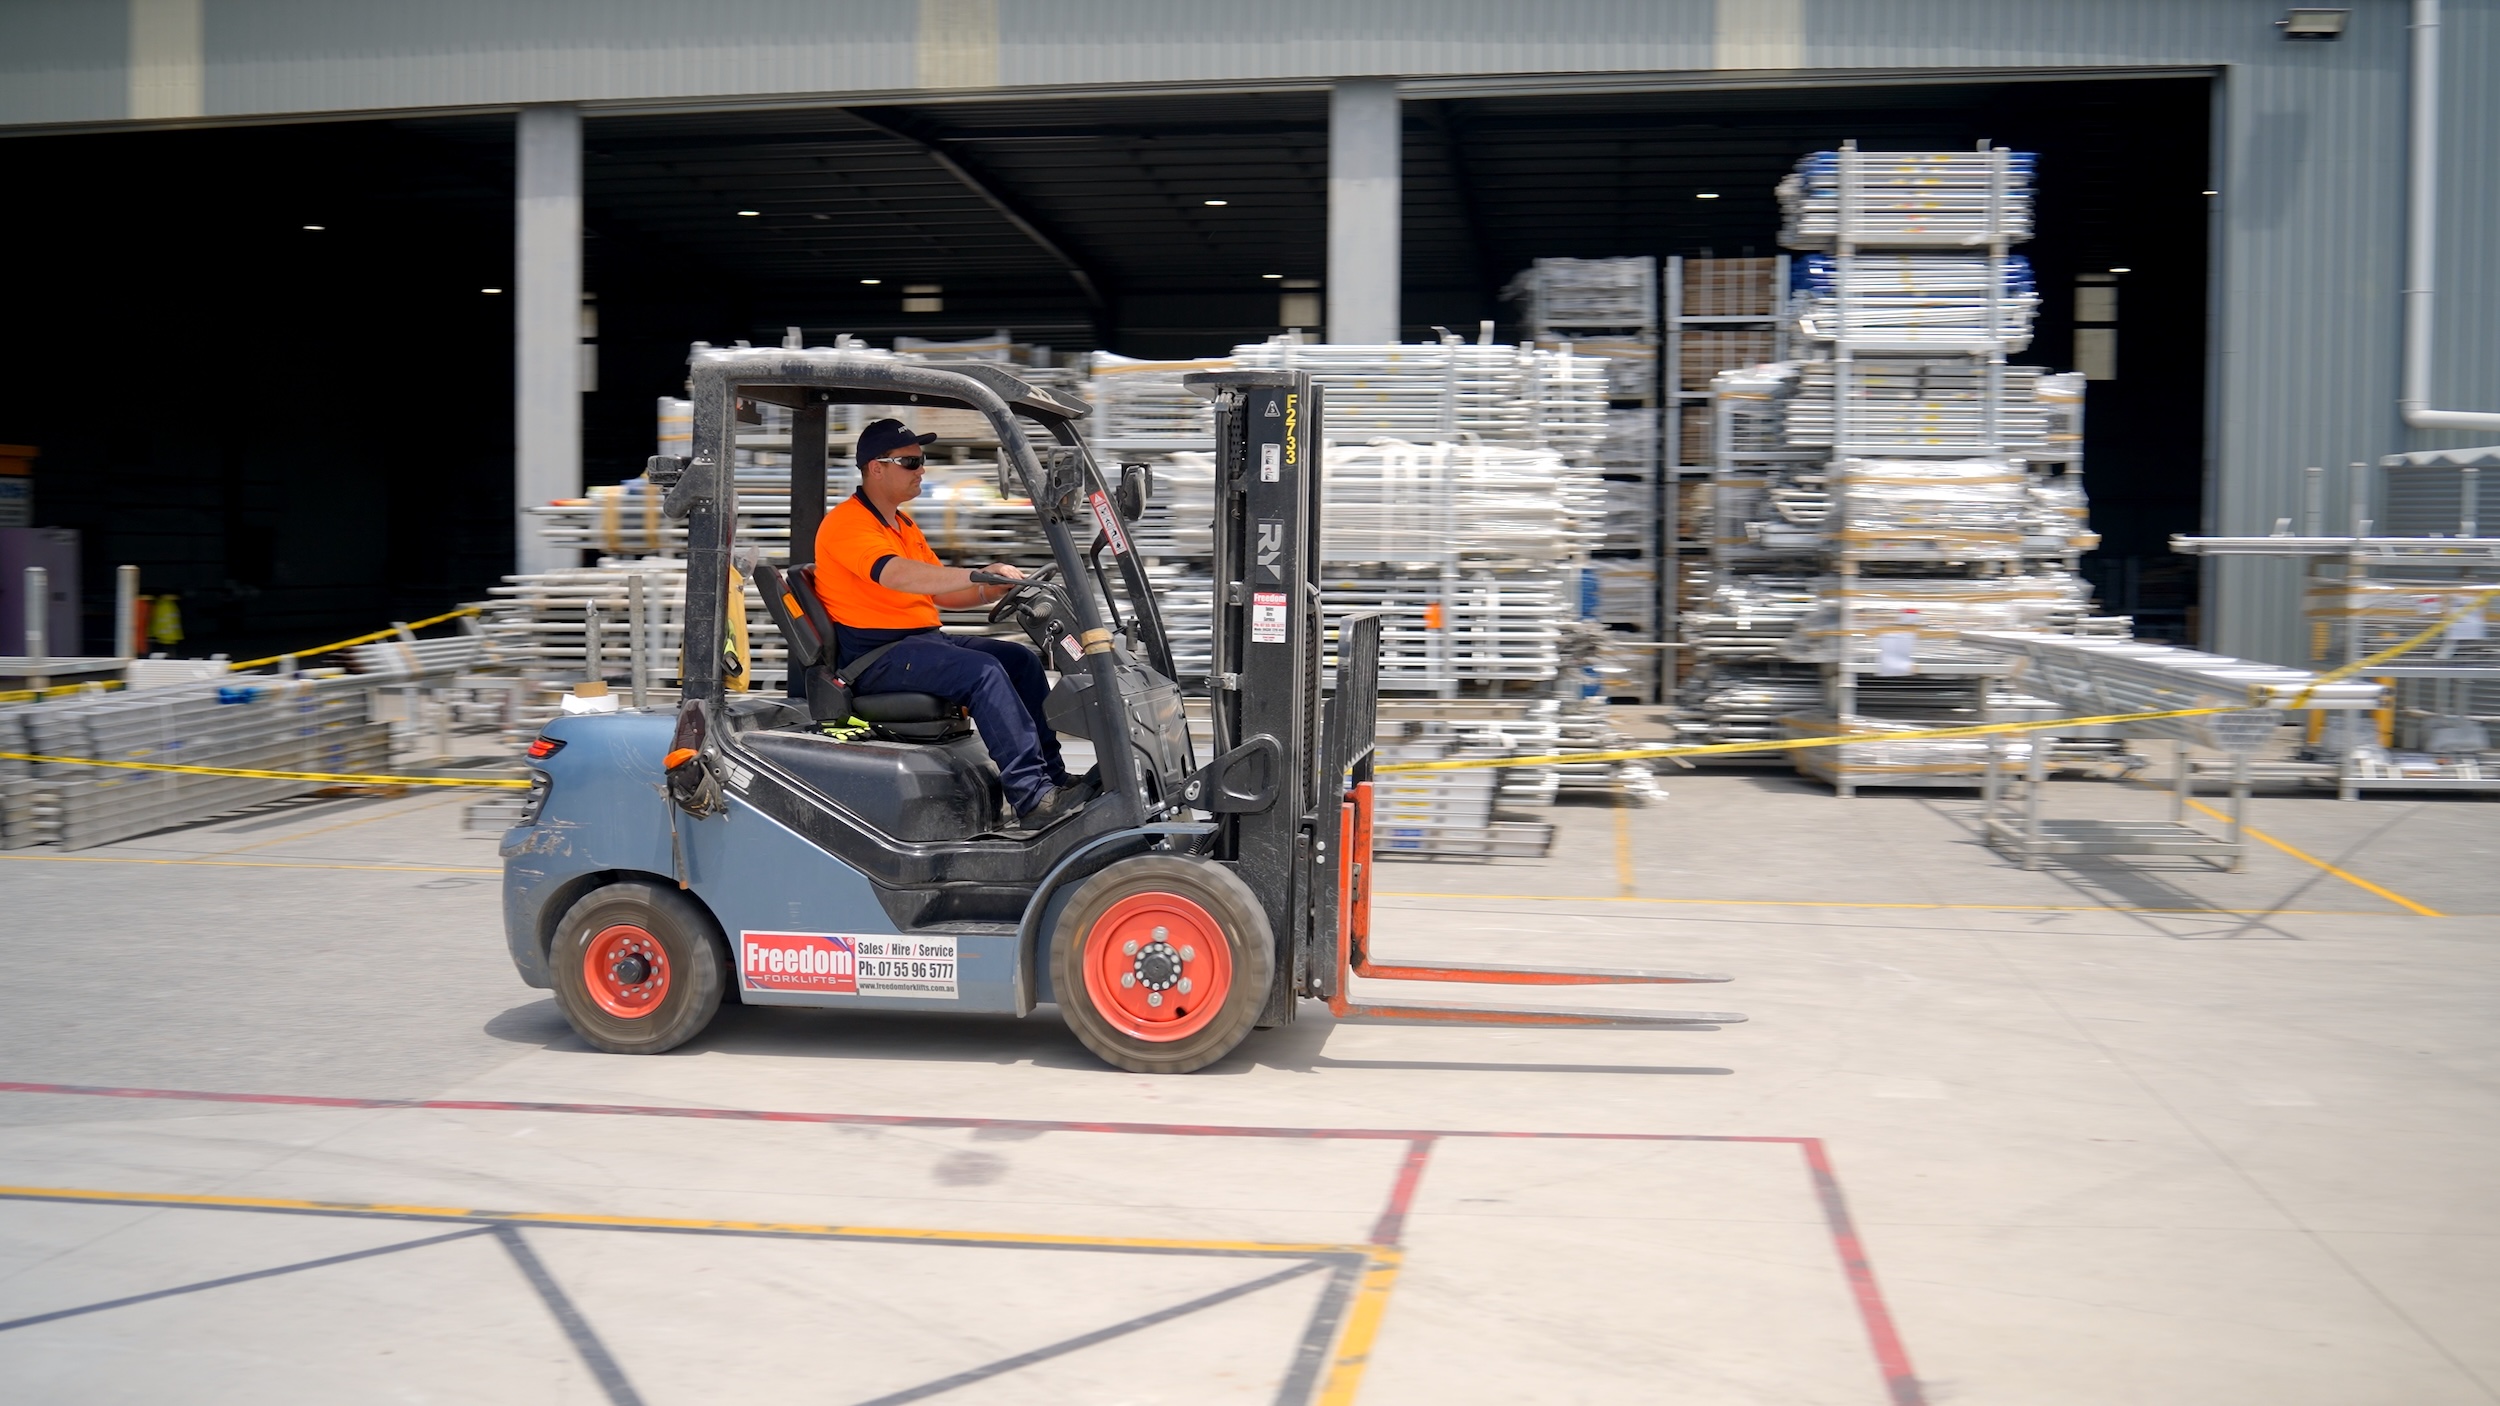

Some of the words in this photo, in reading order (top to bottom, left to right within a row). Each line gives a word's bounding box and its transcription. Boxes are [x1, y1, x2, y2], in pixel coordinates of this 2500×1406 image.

[1286, 394, 1298, 464] F2733
[1253, 593, 1287, 602] Freedom
[858, 942, 884, 955] Sales
[891, 943, 911, 956] Hire
[918, 944, 954, 957] Service
[746, 943, 853, 975] Freedom
[858, 960, 876, 976] Ph:
[878, 961, 892, 976] 07
[893, 962, 909, 977] 55
[911, 962, 926, 978] 96
[929, 963, 954, 979] 5777
[763, 974, 837, 985] FORKLIFTS
[859, 982, 955, 993] www.freedomforklifts.com.au
